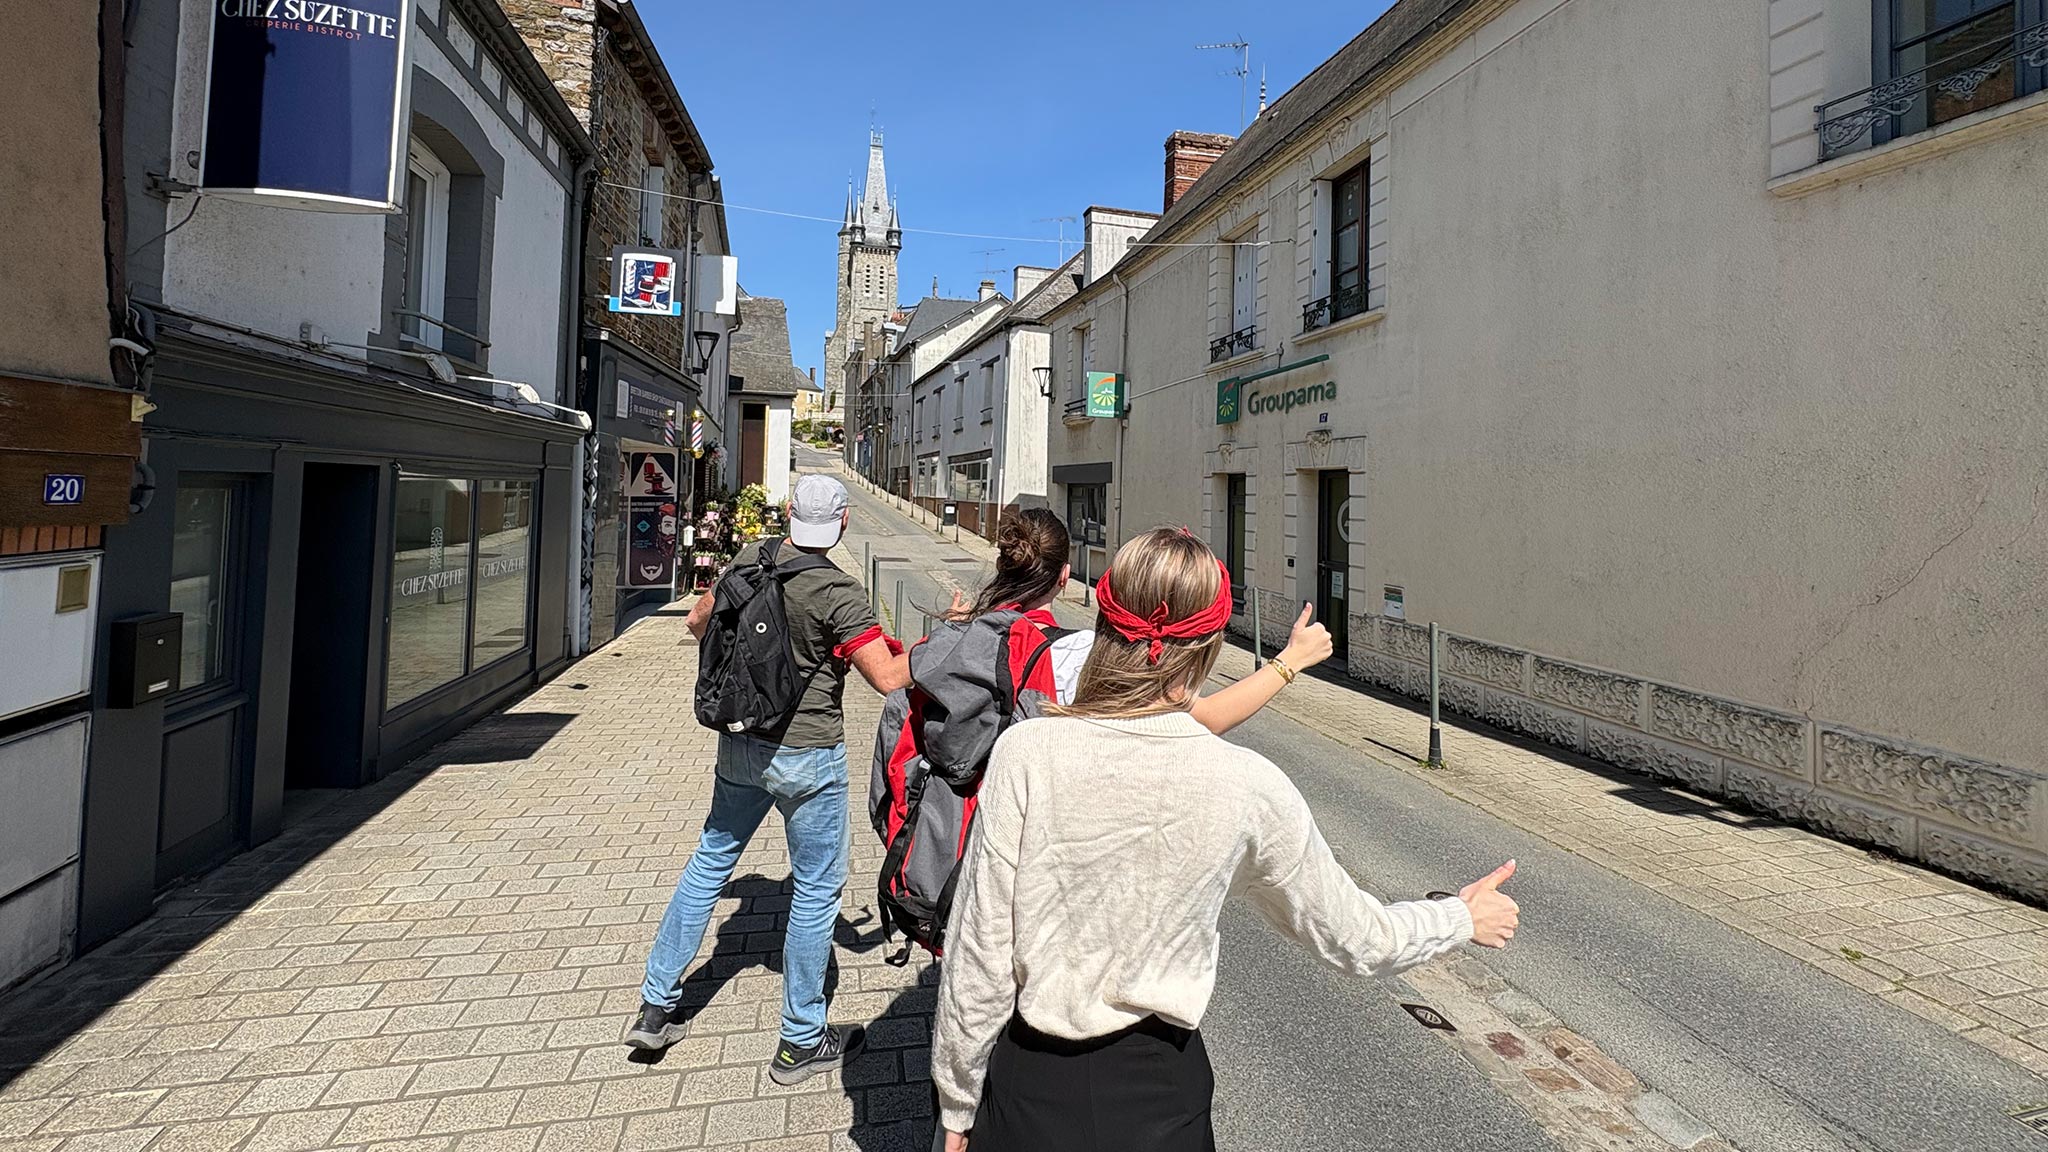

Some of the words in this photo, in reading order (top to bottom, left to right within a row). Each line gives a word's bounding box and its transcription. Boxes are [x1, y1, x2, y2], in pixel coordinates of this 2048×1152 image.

[222, 0, 278, 18] CHEZ
[284, 0, 397, 39] SUZETTE
[307, 24, 361, 41] BISTROT
[1247, 381, 1337, 414] Groupama
[50, 478, 79, 501] 20
[401, 576, 427, 597] CHEZ
[428, 568, 465, 591] SUZETTE
